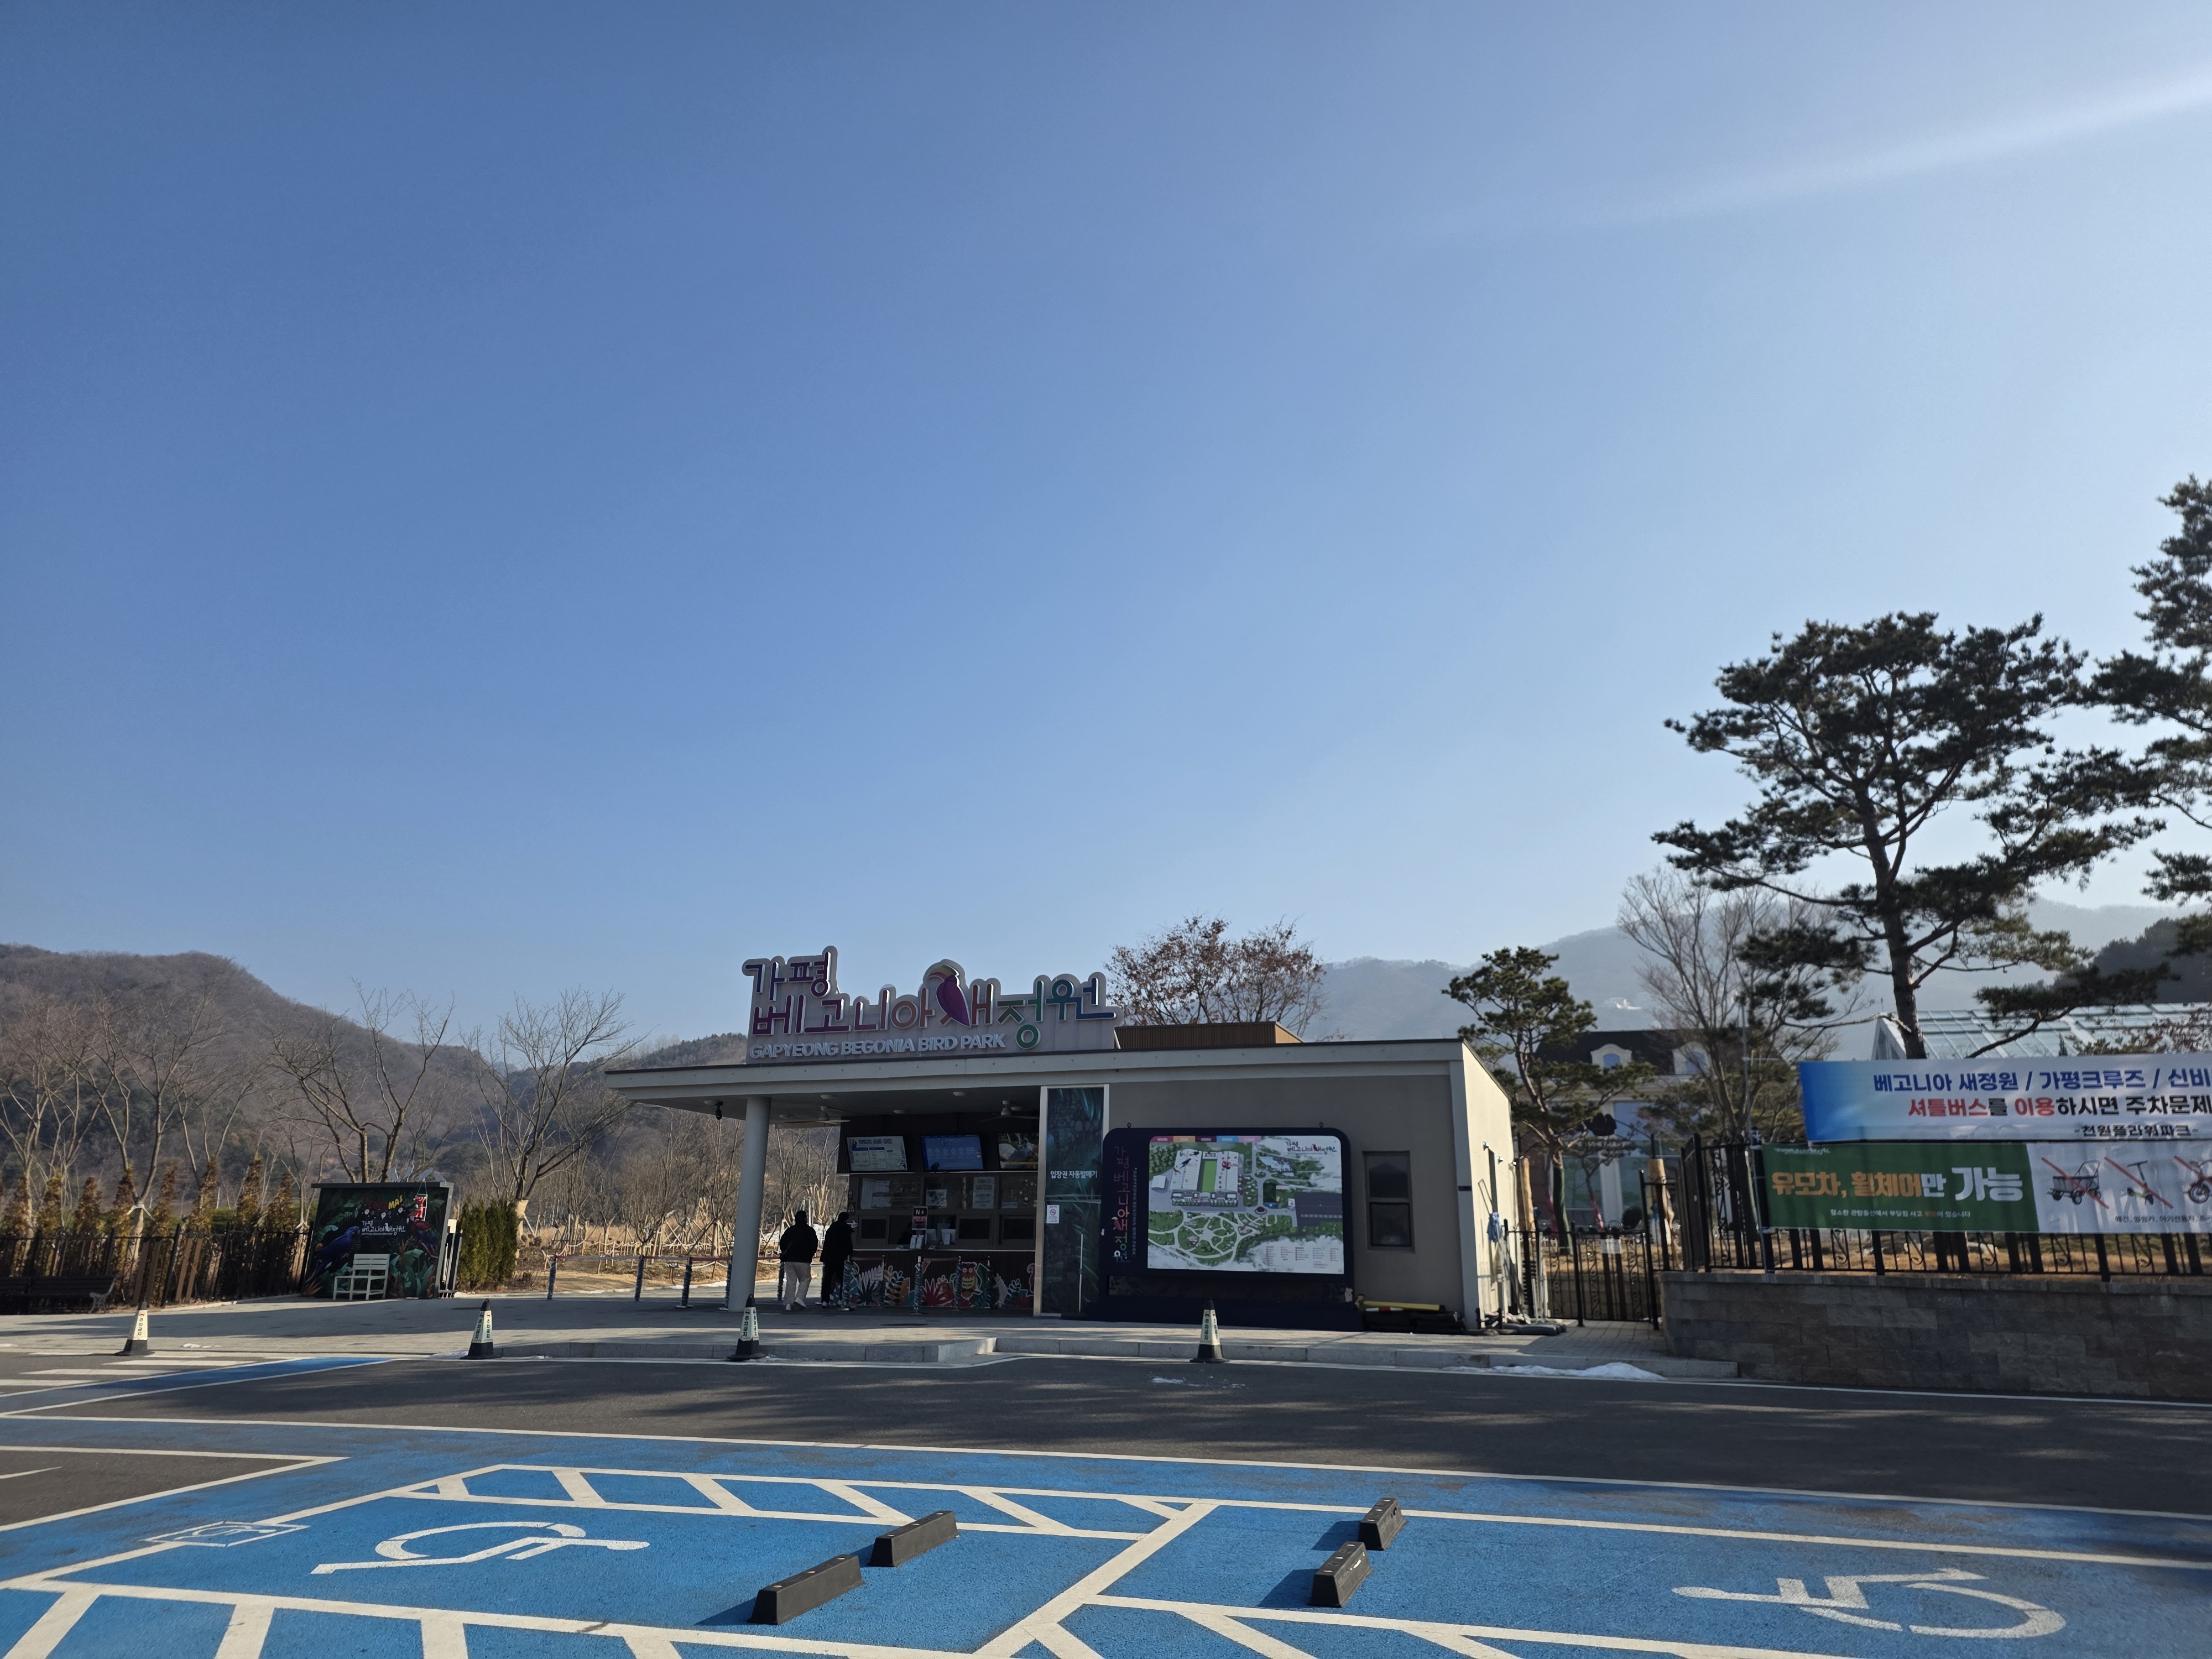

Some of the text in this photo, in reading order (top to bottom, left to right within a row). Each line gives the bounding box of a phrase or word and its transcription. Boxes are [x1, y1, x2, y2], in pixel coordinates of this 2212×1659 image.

[745, 951, 831, 1001] 가평
[749, 1033, 1006, 1058] GAPYEONG BEGONIA BIRD PARK
[1873, 1073, 1952, 1092] 베고니아
[1959, 1072, 2019, 1091] 새정원
[2039, 1070, 2146, 1090] 가평크루즈
[2168, 1068, 2212, 1088] 신비
[1908, 1094, 2212, 1117] 셔틀버스를 이용하시면 주차문제
[1050, 1170, 1098, 1179] 입장권 자동발매기
[1772, 1167, 2023, 1201] 유모차, 휠체어만 가능
